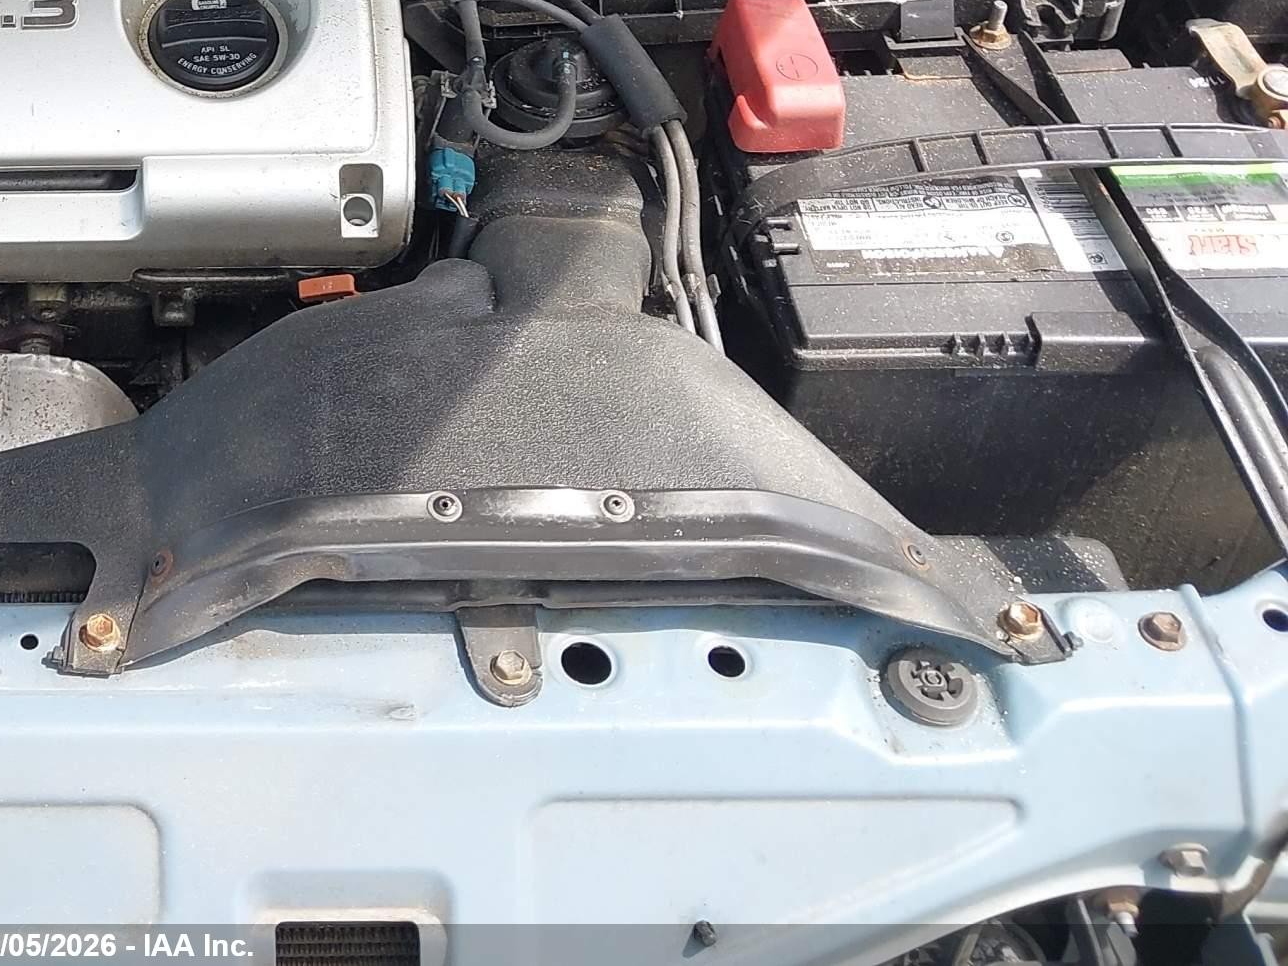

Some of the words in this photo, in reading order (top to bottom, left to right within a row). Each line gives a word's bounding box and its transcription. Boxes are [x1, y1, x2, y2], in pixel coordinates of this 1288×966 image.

[177, 58, 208, 74] ENERGY
[210, 52, 257, 74] CONSERVING
[213, 53, 241, 61] 5W-30
